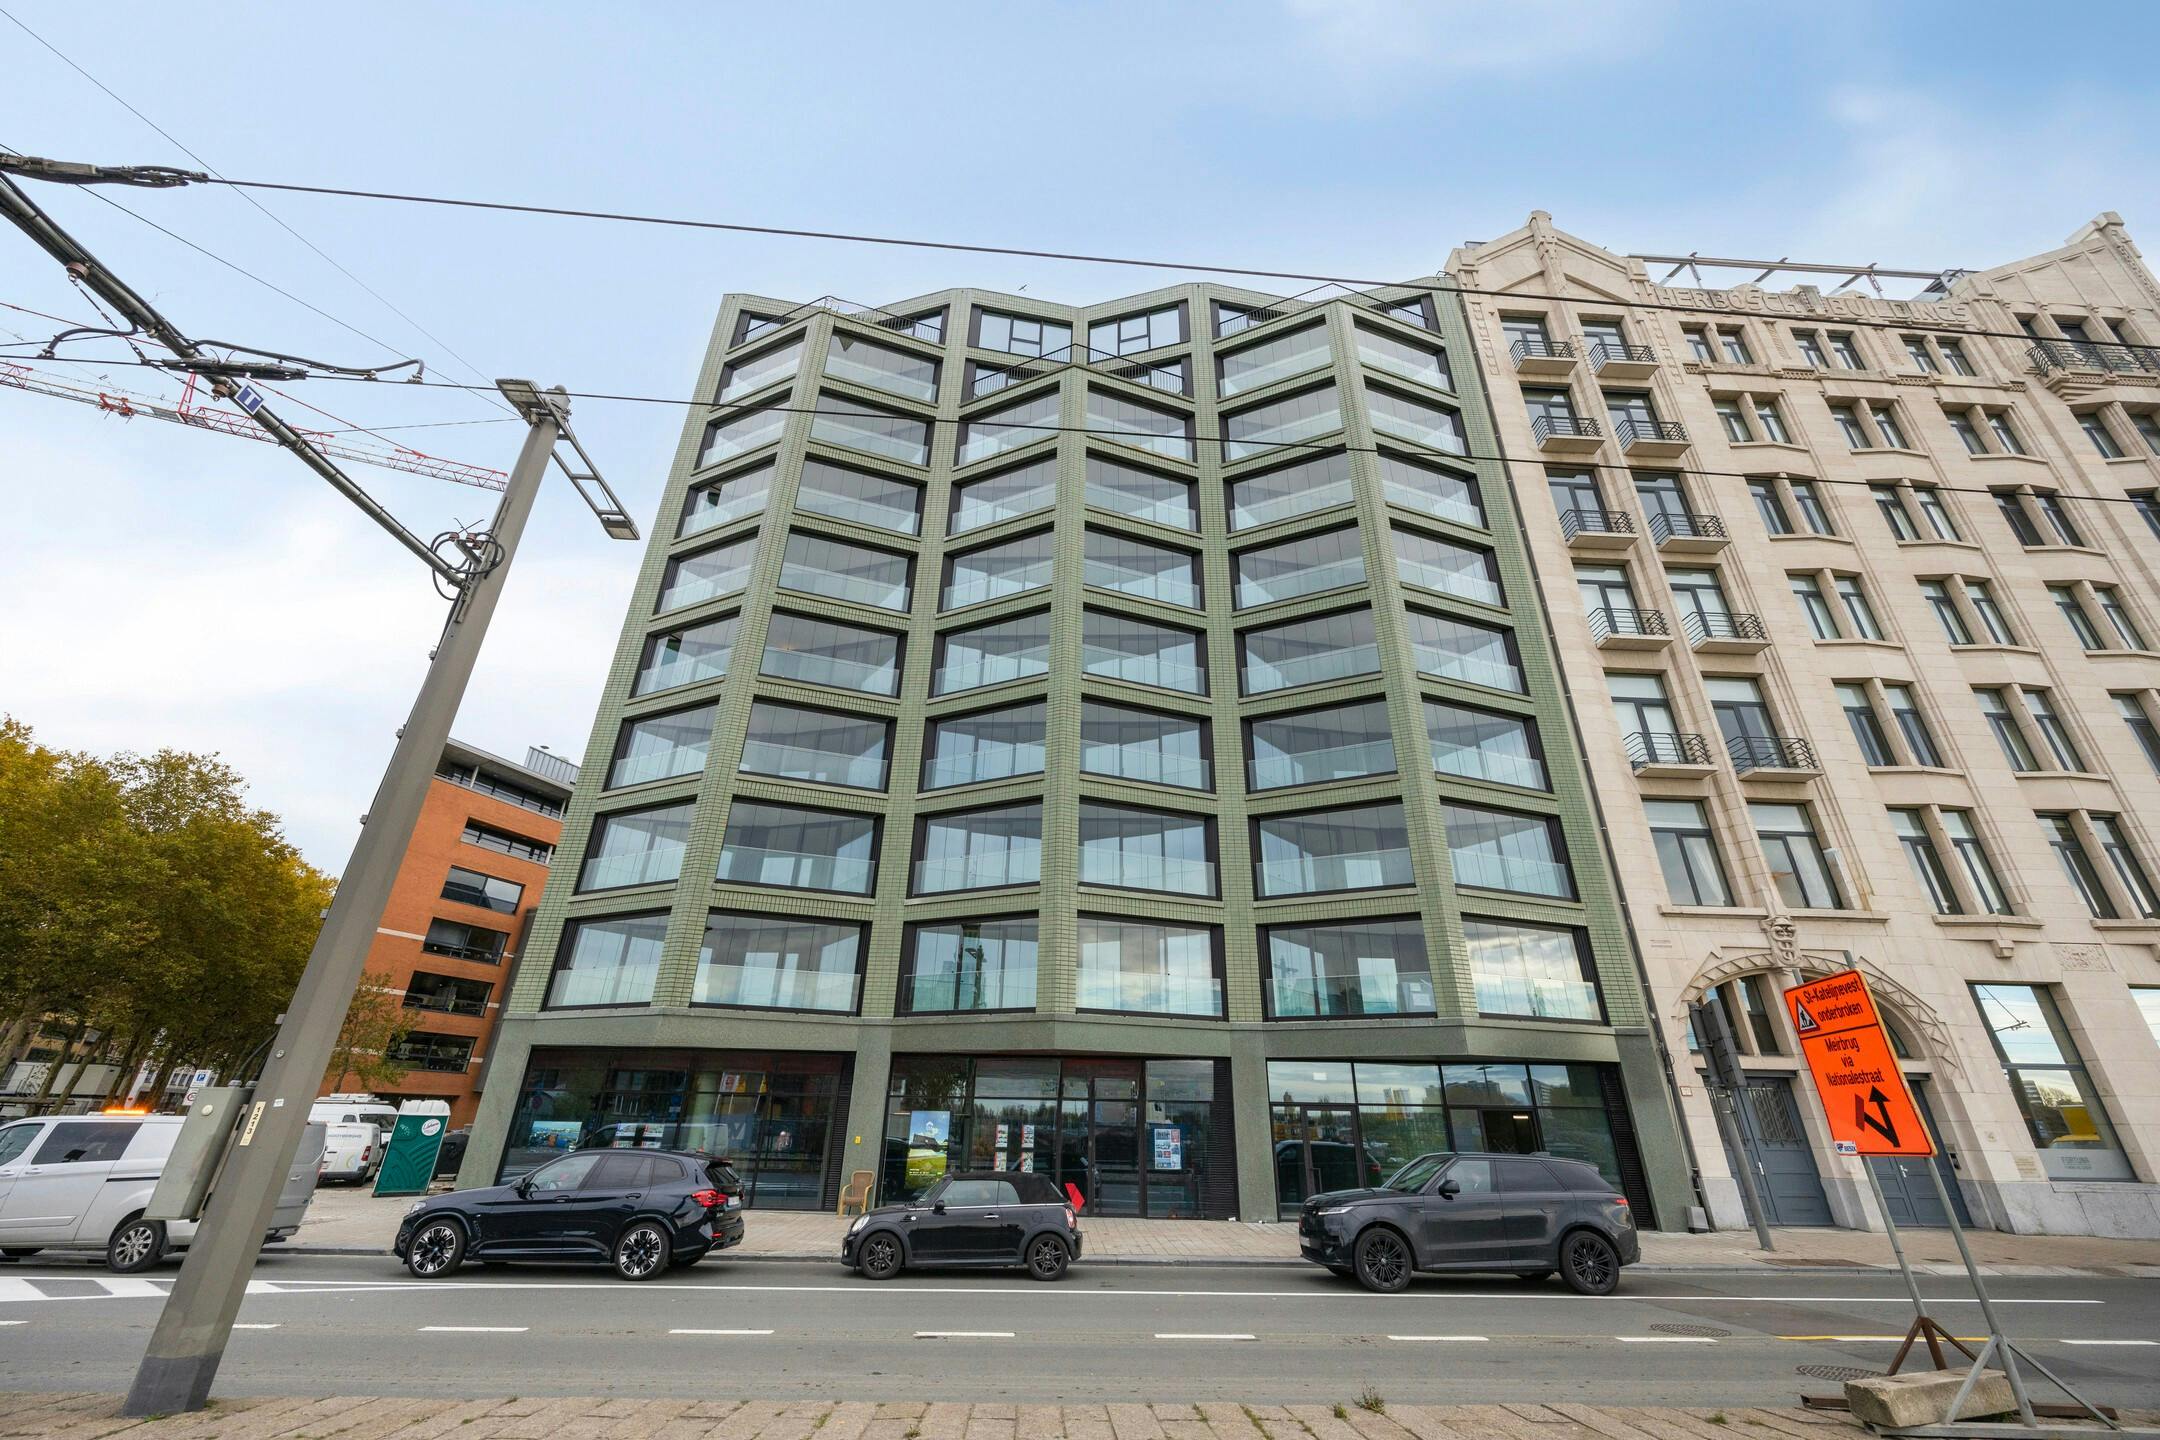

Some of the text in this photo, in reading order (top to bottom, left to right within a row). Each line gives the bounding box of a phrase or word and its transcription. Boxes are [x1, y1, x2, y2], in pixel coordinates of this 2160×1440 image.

[1655, 287, 1972, 323] HERBOSCH BUILDINGS
[1803, 978, 1862, 1004] St-Katelijnevest
[1817, 1001, 1864, 1022] onderbroken
[1824, 1036, 1860, 1052] Meirbrug
[1841, 1054, 1855, 1068] via
[1825, 1068, 1885, 1087] Nationalestraat
